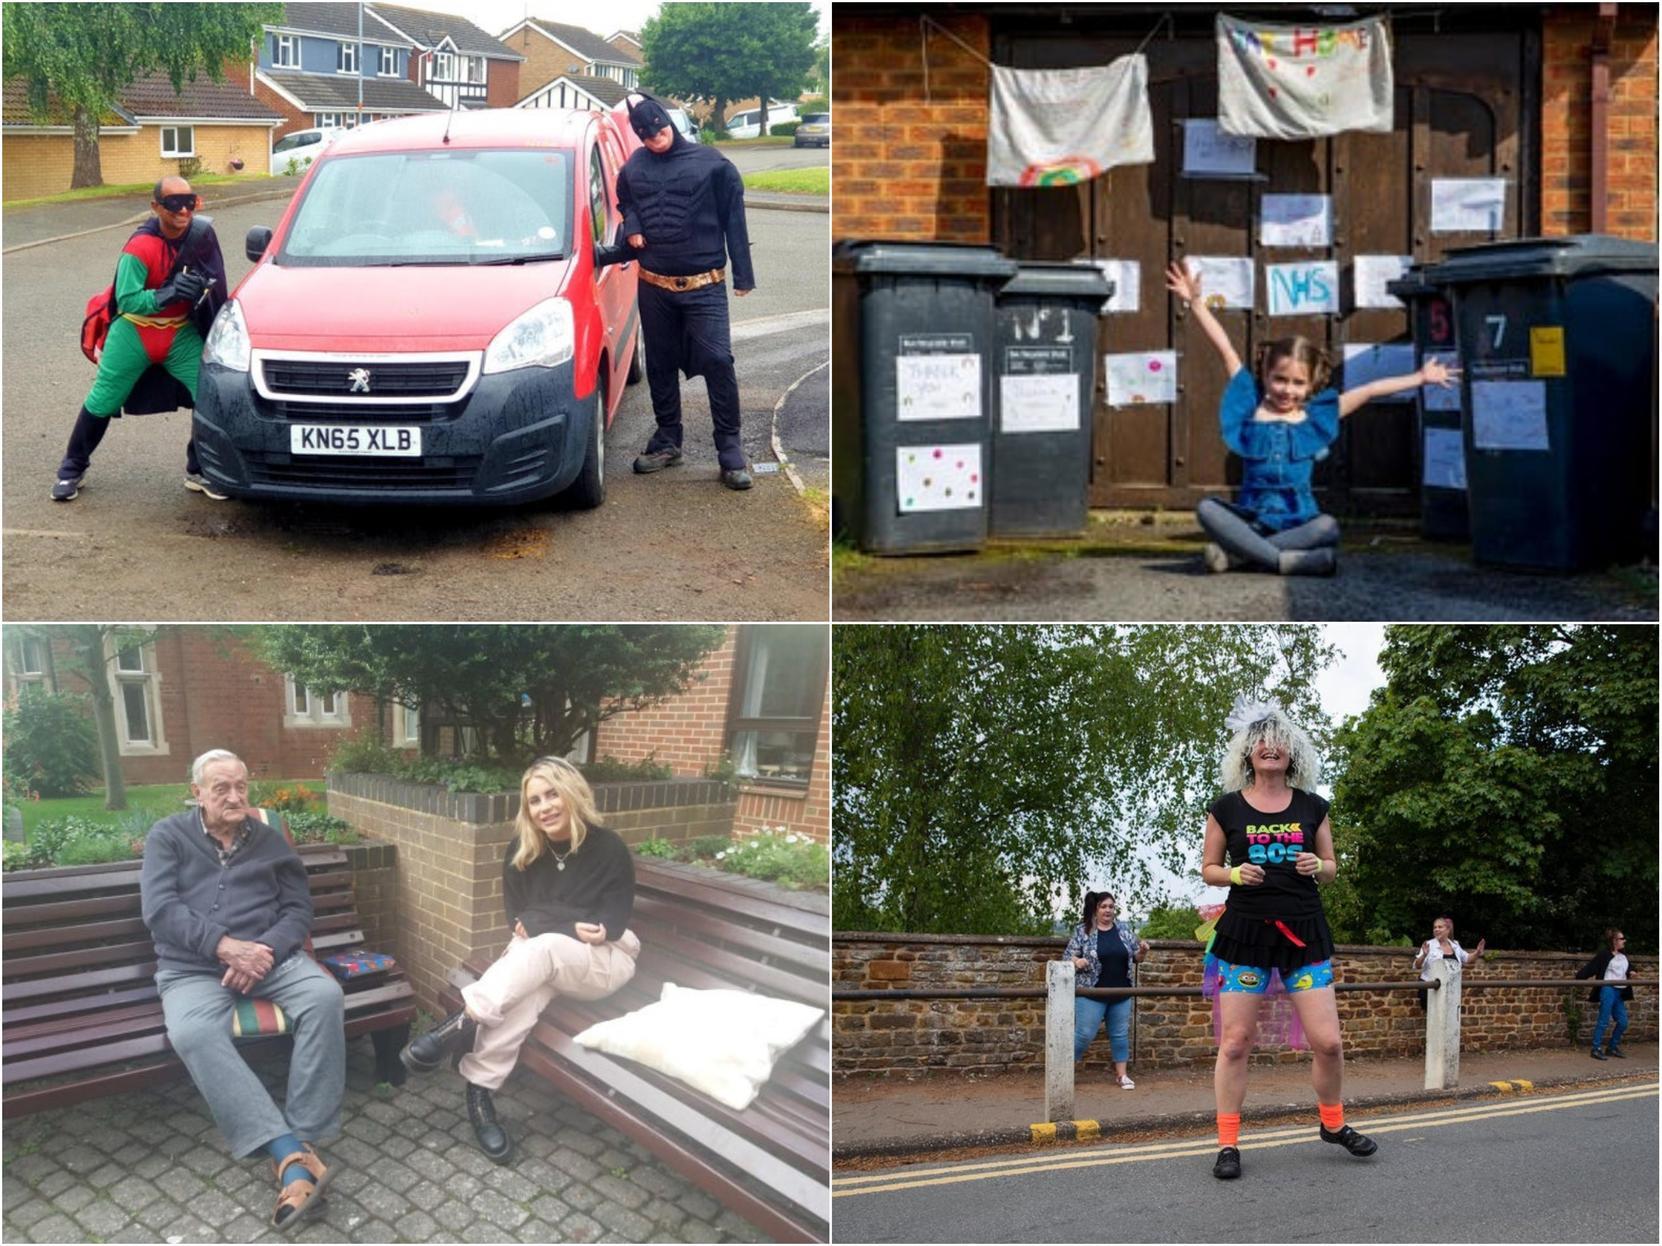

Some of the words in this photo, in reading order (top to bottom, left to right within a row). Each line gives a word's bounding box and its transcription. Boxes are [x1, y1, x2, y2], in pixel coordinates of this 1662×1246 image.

[1271, 266, 1331, 313] NHS
[1431, 300, 1450, 341] 5
[1485, 314, 1507, 348] 7
[302, 427, 360, 449] KN65
[367, 428, 411, 450] XLB
[1246, 823, 1292, 834] BACK
[1247, 833, 1271, 844] TO
[1274, 832, 1304, 844] THE
